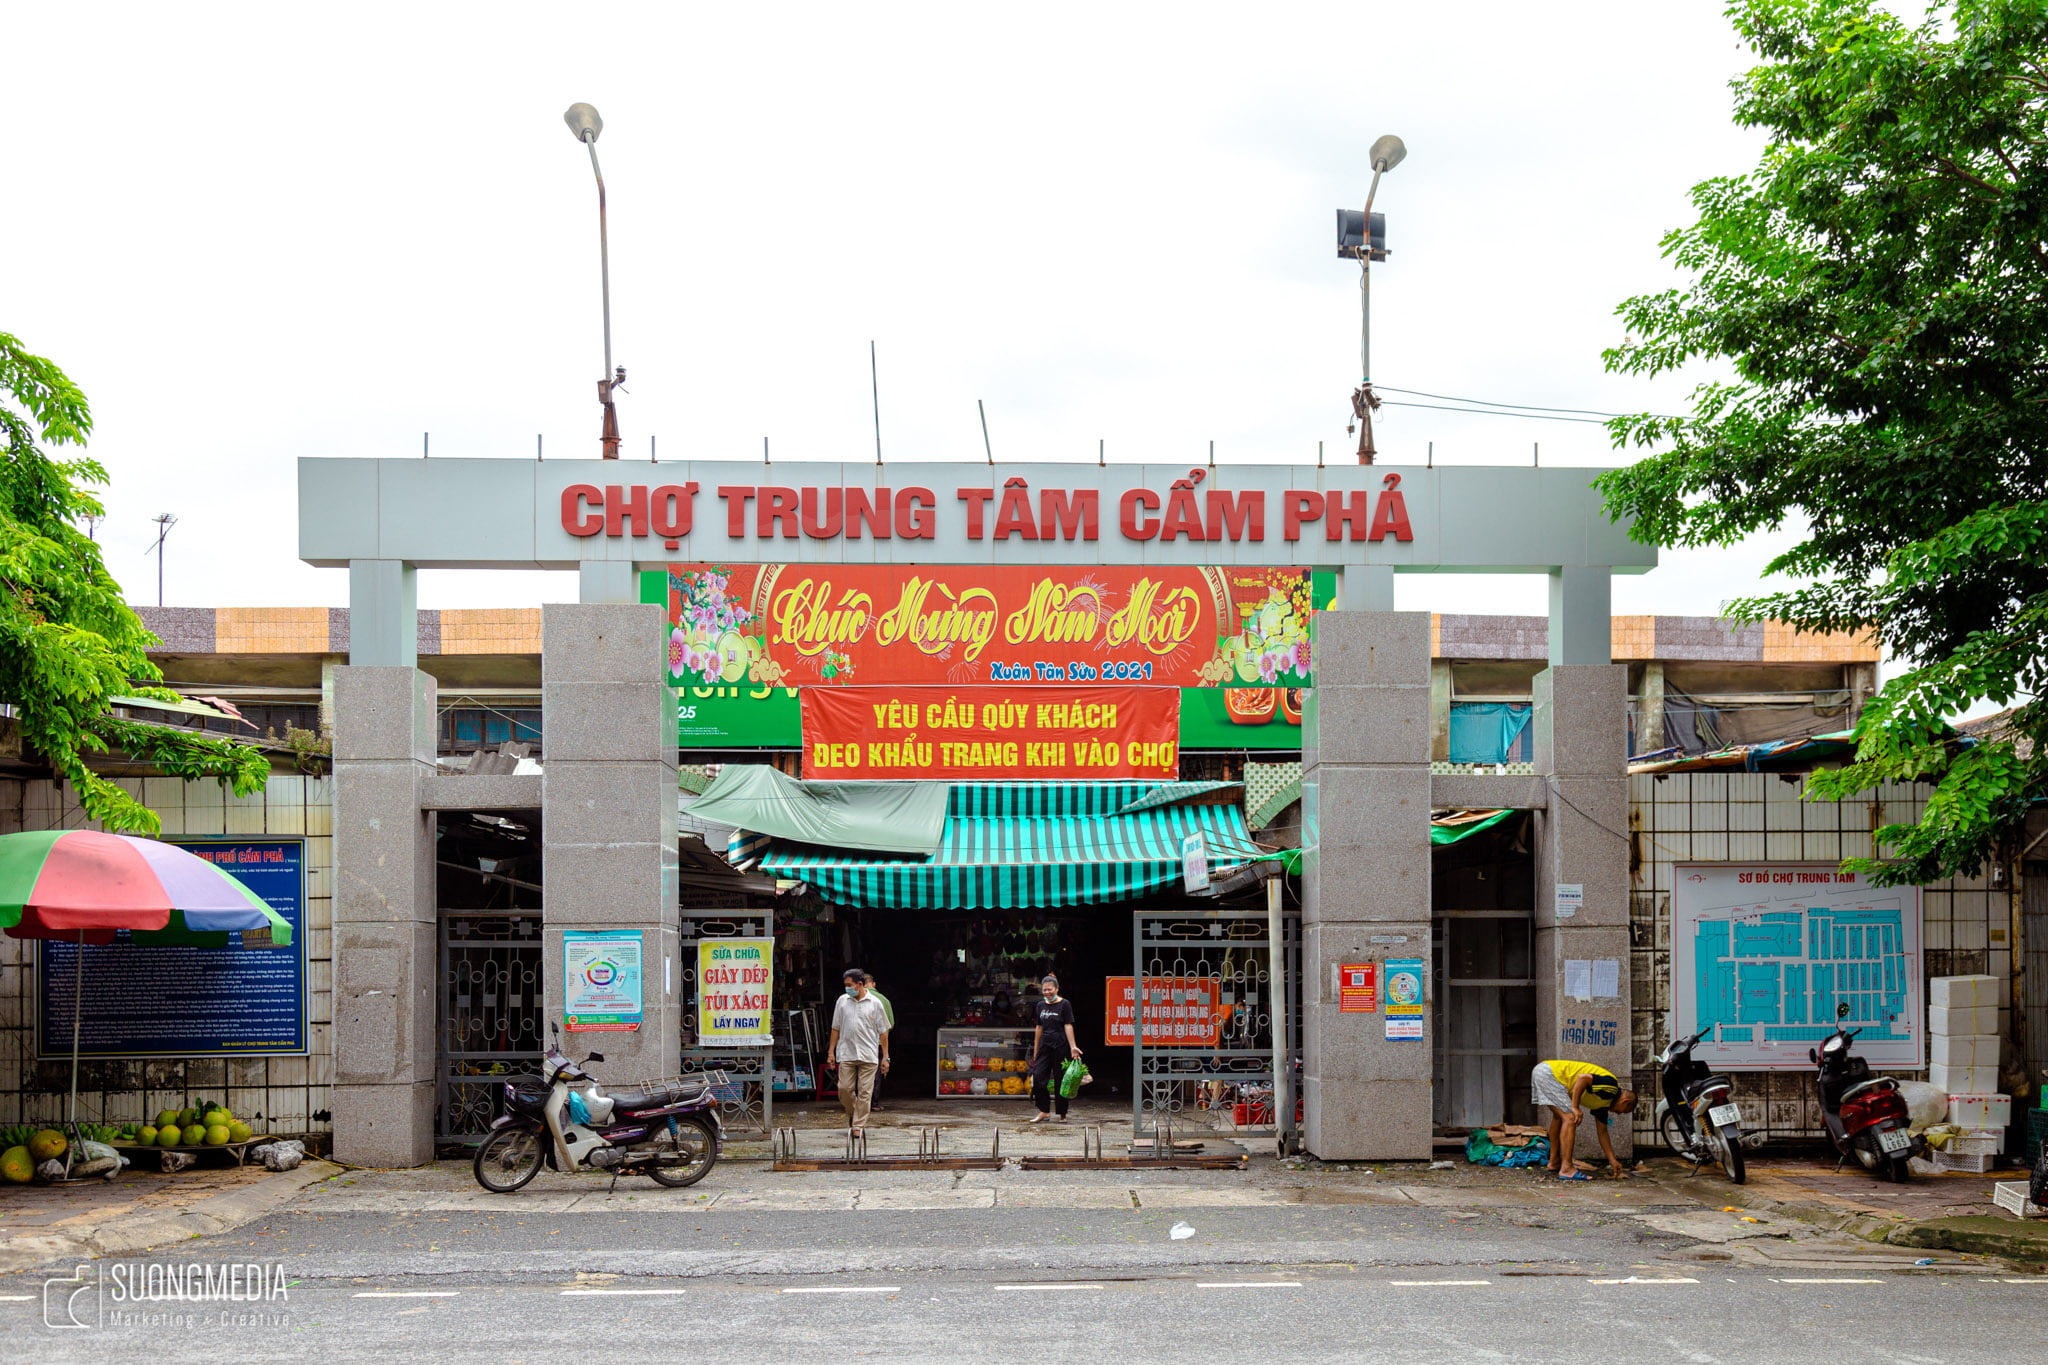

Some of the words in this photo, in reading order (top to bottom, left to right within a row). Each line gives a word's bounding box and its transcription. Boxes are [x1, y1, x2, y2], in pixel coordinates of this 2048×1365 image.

[561, 482, 699, 550] CHỢ
[718, 486, 936, 540] TRUNG
[957, 477, 1099, 542] TÂM
[1120, 468, 1266, 543] CẨM
[1284, 473, 1414, 543] PHẢ
[773, 578, 873, 656] Chúc
[875, 576, 998, 663] Mừng
[1005, 577, 1101, 646] Năm
[1106, 577, 1200, 656] Mới
[991, 661, 1031, 680] Xuân
[1034, 661, 1065, 680] Tân
[1068, 662, 1097, 680] Sửu
[1101, 661, 1153, 680] 2021
[873, 698, 918, 728] YÊU
[926, 696, 975, 728] CẦU
[1036, 699, 1117, 728] KHÁCH
[813, 743, 860, 768] ĐEO
[868, 732, 933, 767] KHẨU
[940, 742, 1018, 767] TRANG
[1026, 742, 1066, 767] KHI
[1073, 737, 1119, 767] VÀO
[1127, 740, 1176, 772] CHỢ
[1772, 871, 1794, 886] CHỢ
[1796, 872, 1831, 883] TRUNG
[712, 945, 732, 959] SỬA
[734, 946, 761, 959] CHỮA
[704, 964, 740, 984] GIÀY
[742, 963, 769, 984] DÉP
[704, 990, 729, 1010] TÚI
[731, 989, 769, 1010] XÁCH
[714, 1014, 732, 1029] LẤY
[734, 1017, 760, 1028] NGAY
